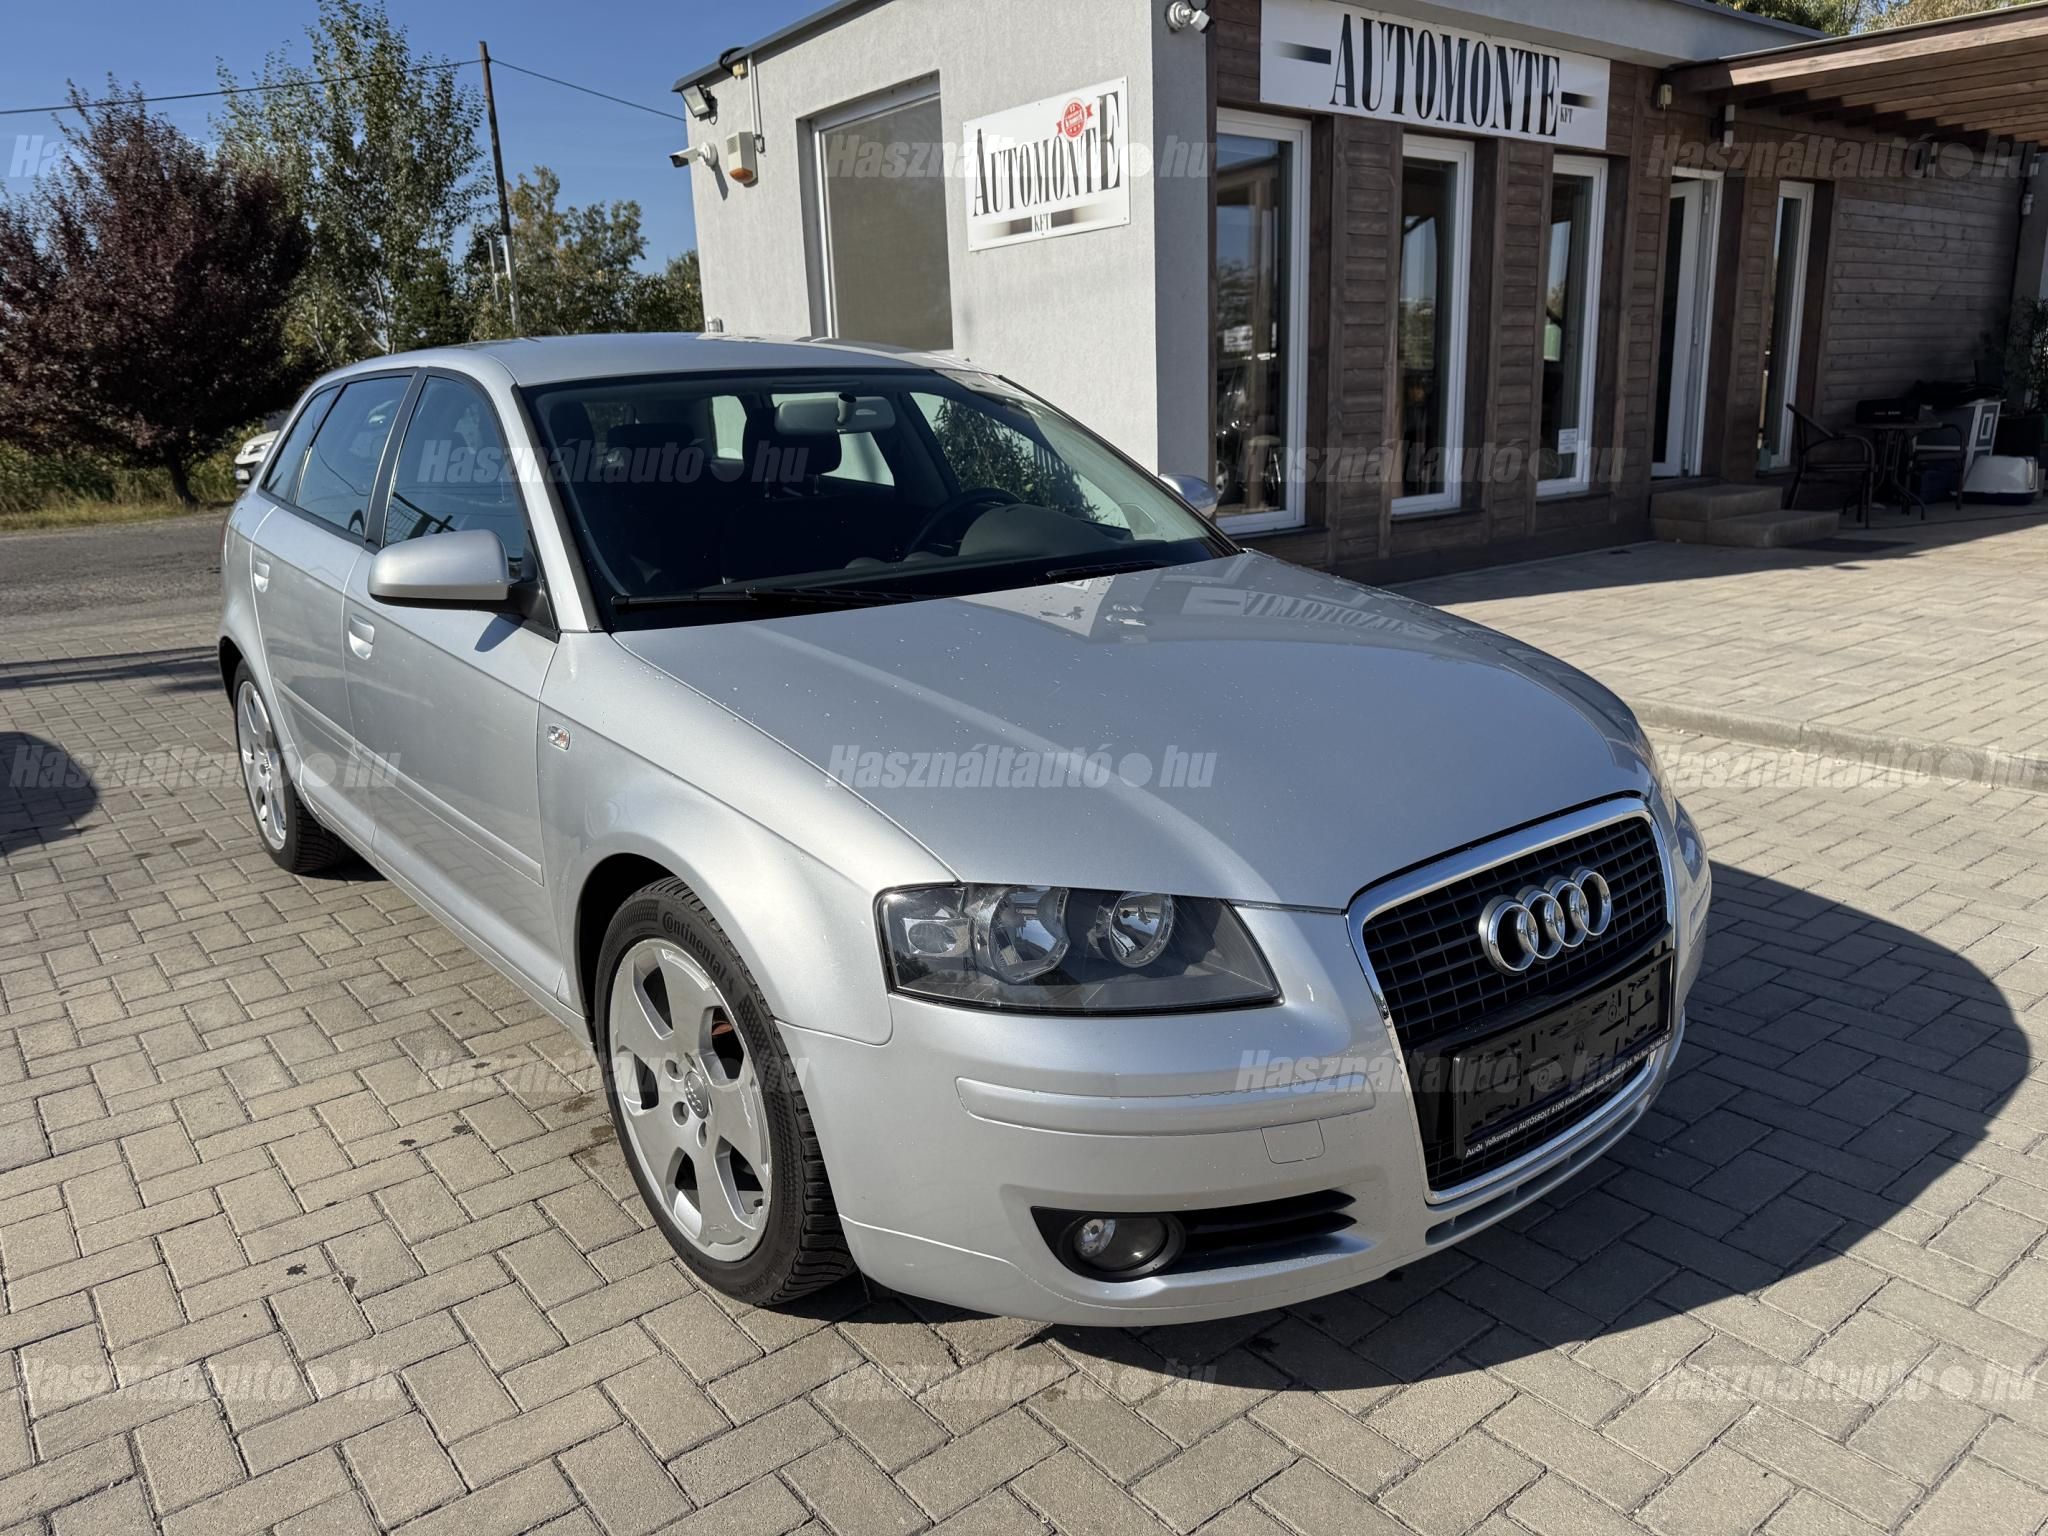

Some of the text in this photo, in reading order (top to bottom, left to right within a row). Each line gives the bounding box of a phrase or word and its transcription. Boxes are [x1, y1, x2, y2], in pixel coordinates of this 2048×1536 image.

[1329, 14, 1560, 137] AUTOMONTE
[1560, 107, 1573, 124] KFT
[1034, 213, 1050, 232] KFT
[662, 911, 727, 981] Continental
